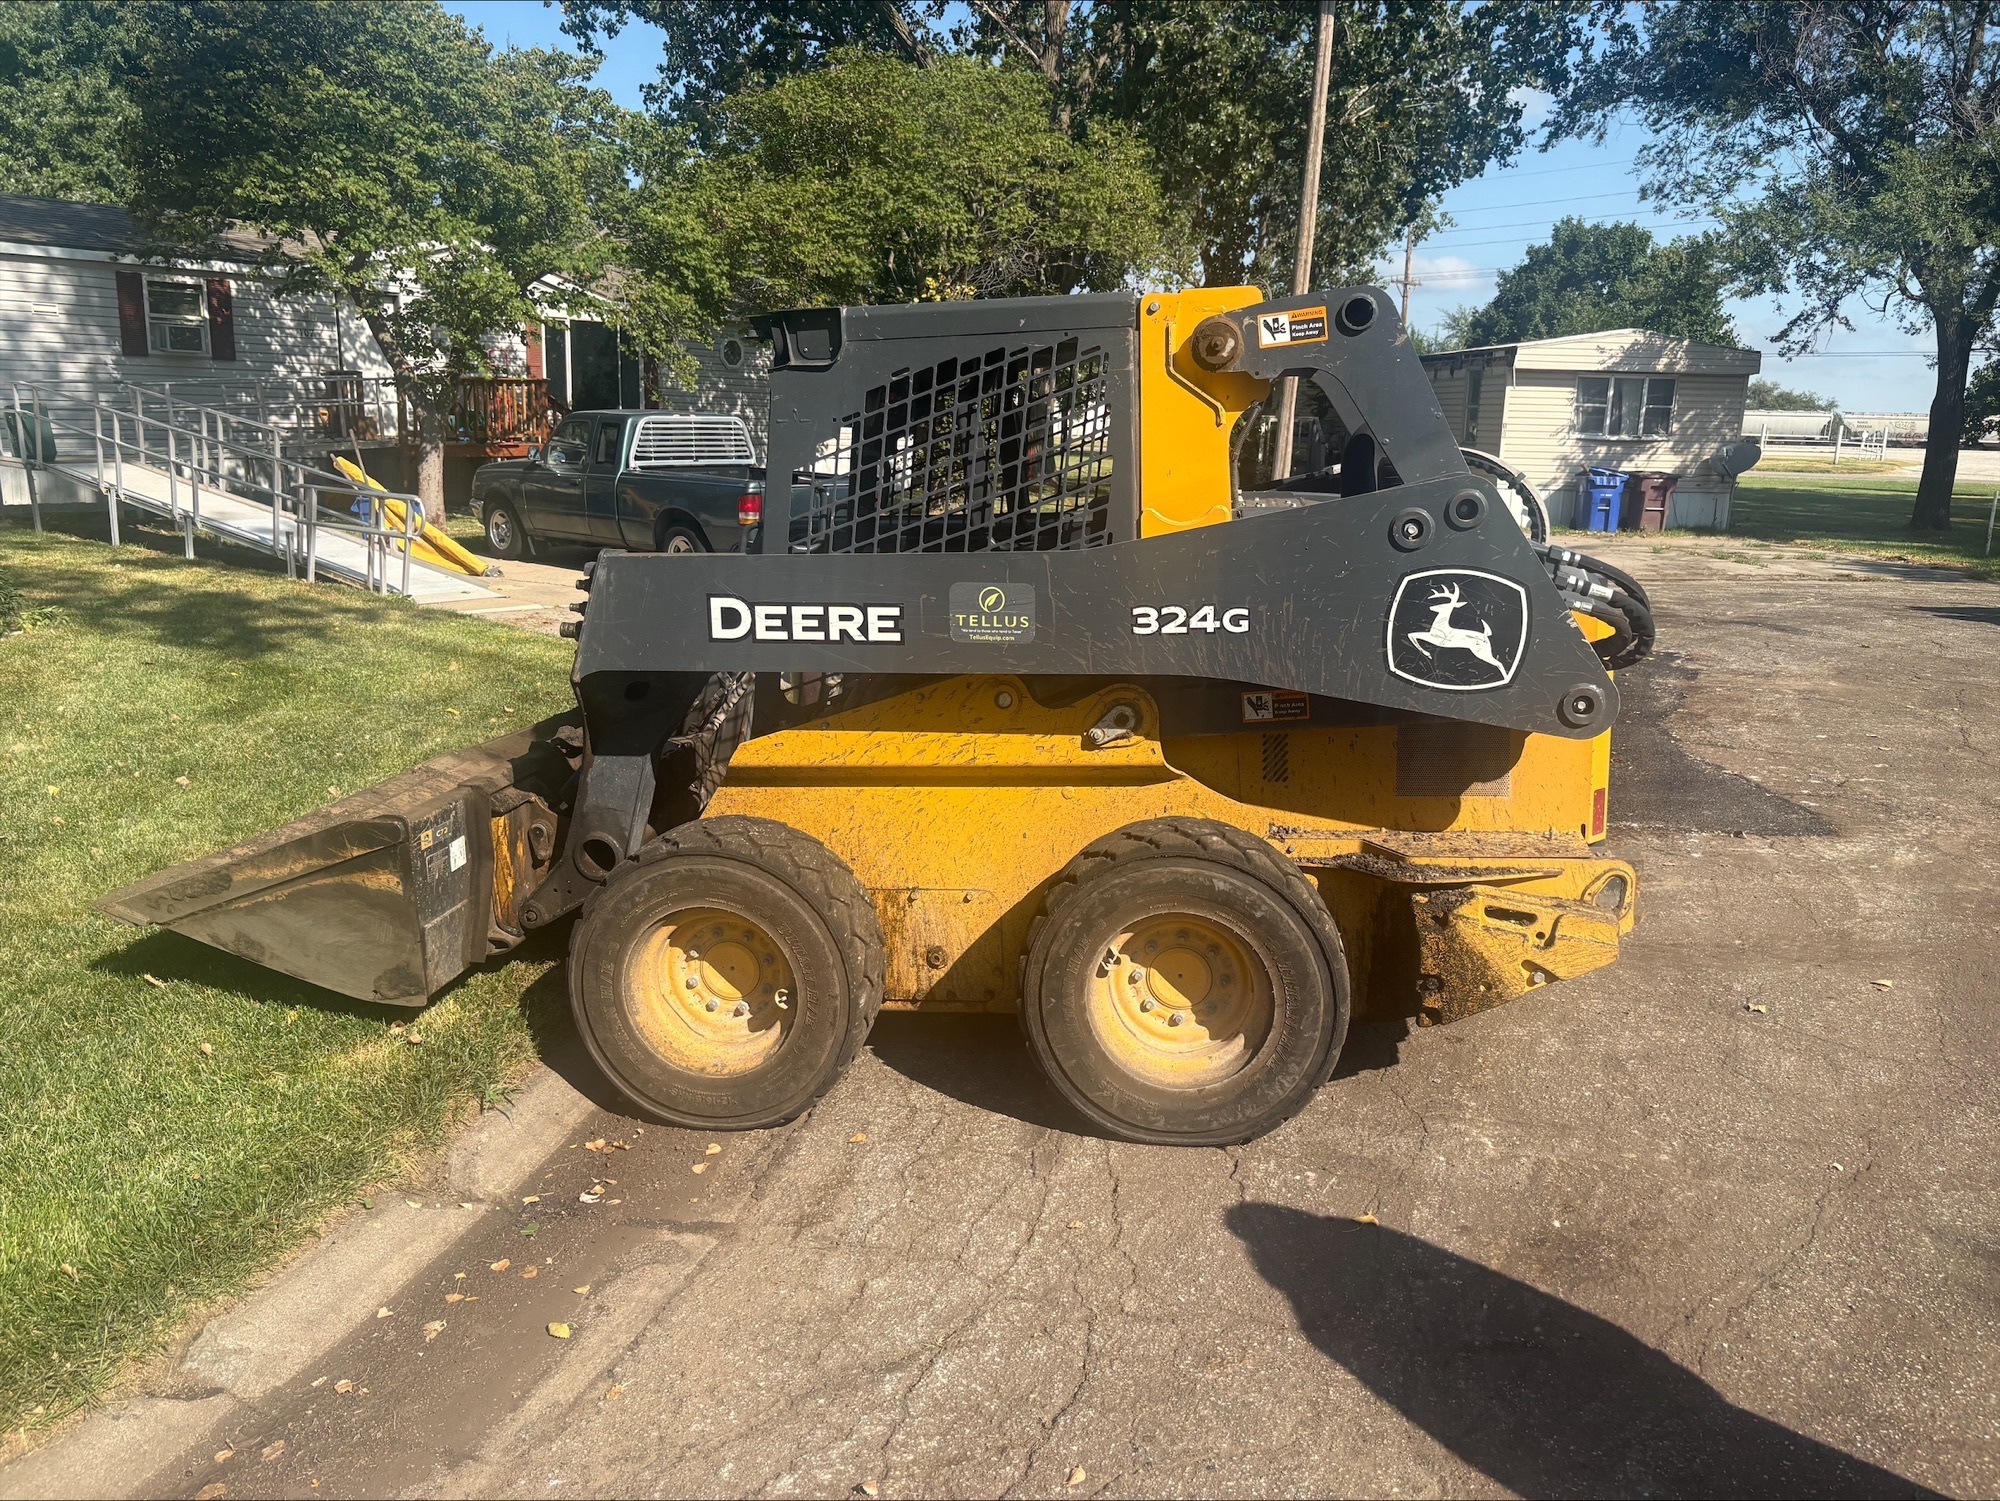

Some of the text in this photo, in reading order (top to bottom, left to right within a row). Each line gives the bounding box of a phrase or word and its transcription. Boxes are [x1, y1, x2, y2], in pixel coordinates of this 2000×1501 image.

[1297, 310, 1323, 318] WARNING
[1291, 323, 1309, 331] Pinch
[1305, 329, 1319, 337] Away
[709, 597, 902, 642] DEERE
[955, 614, 1029, 628] TELLUS
[1131, 605, 1250, 635] 324G
